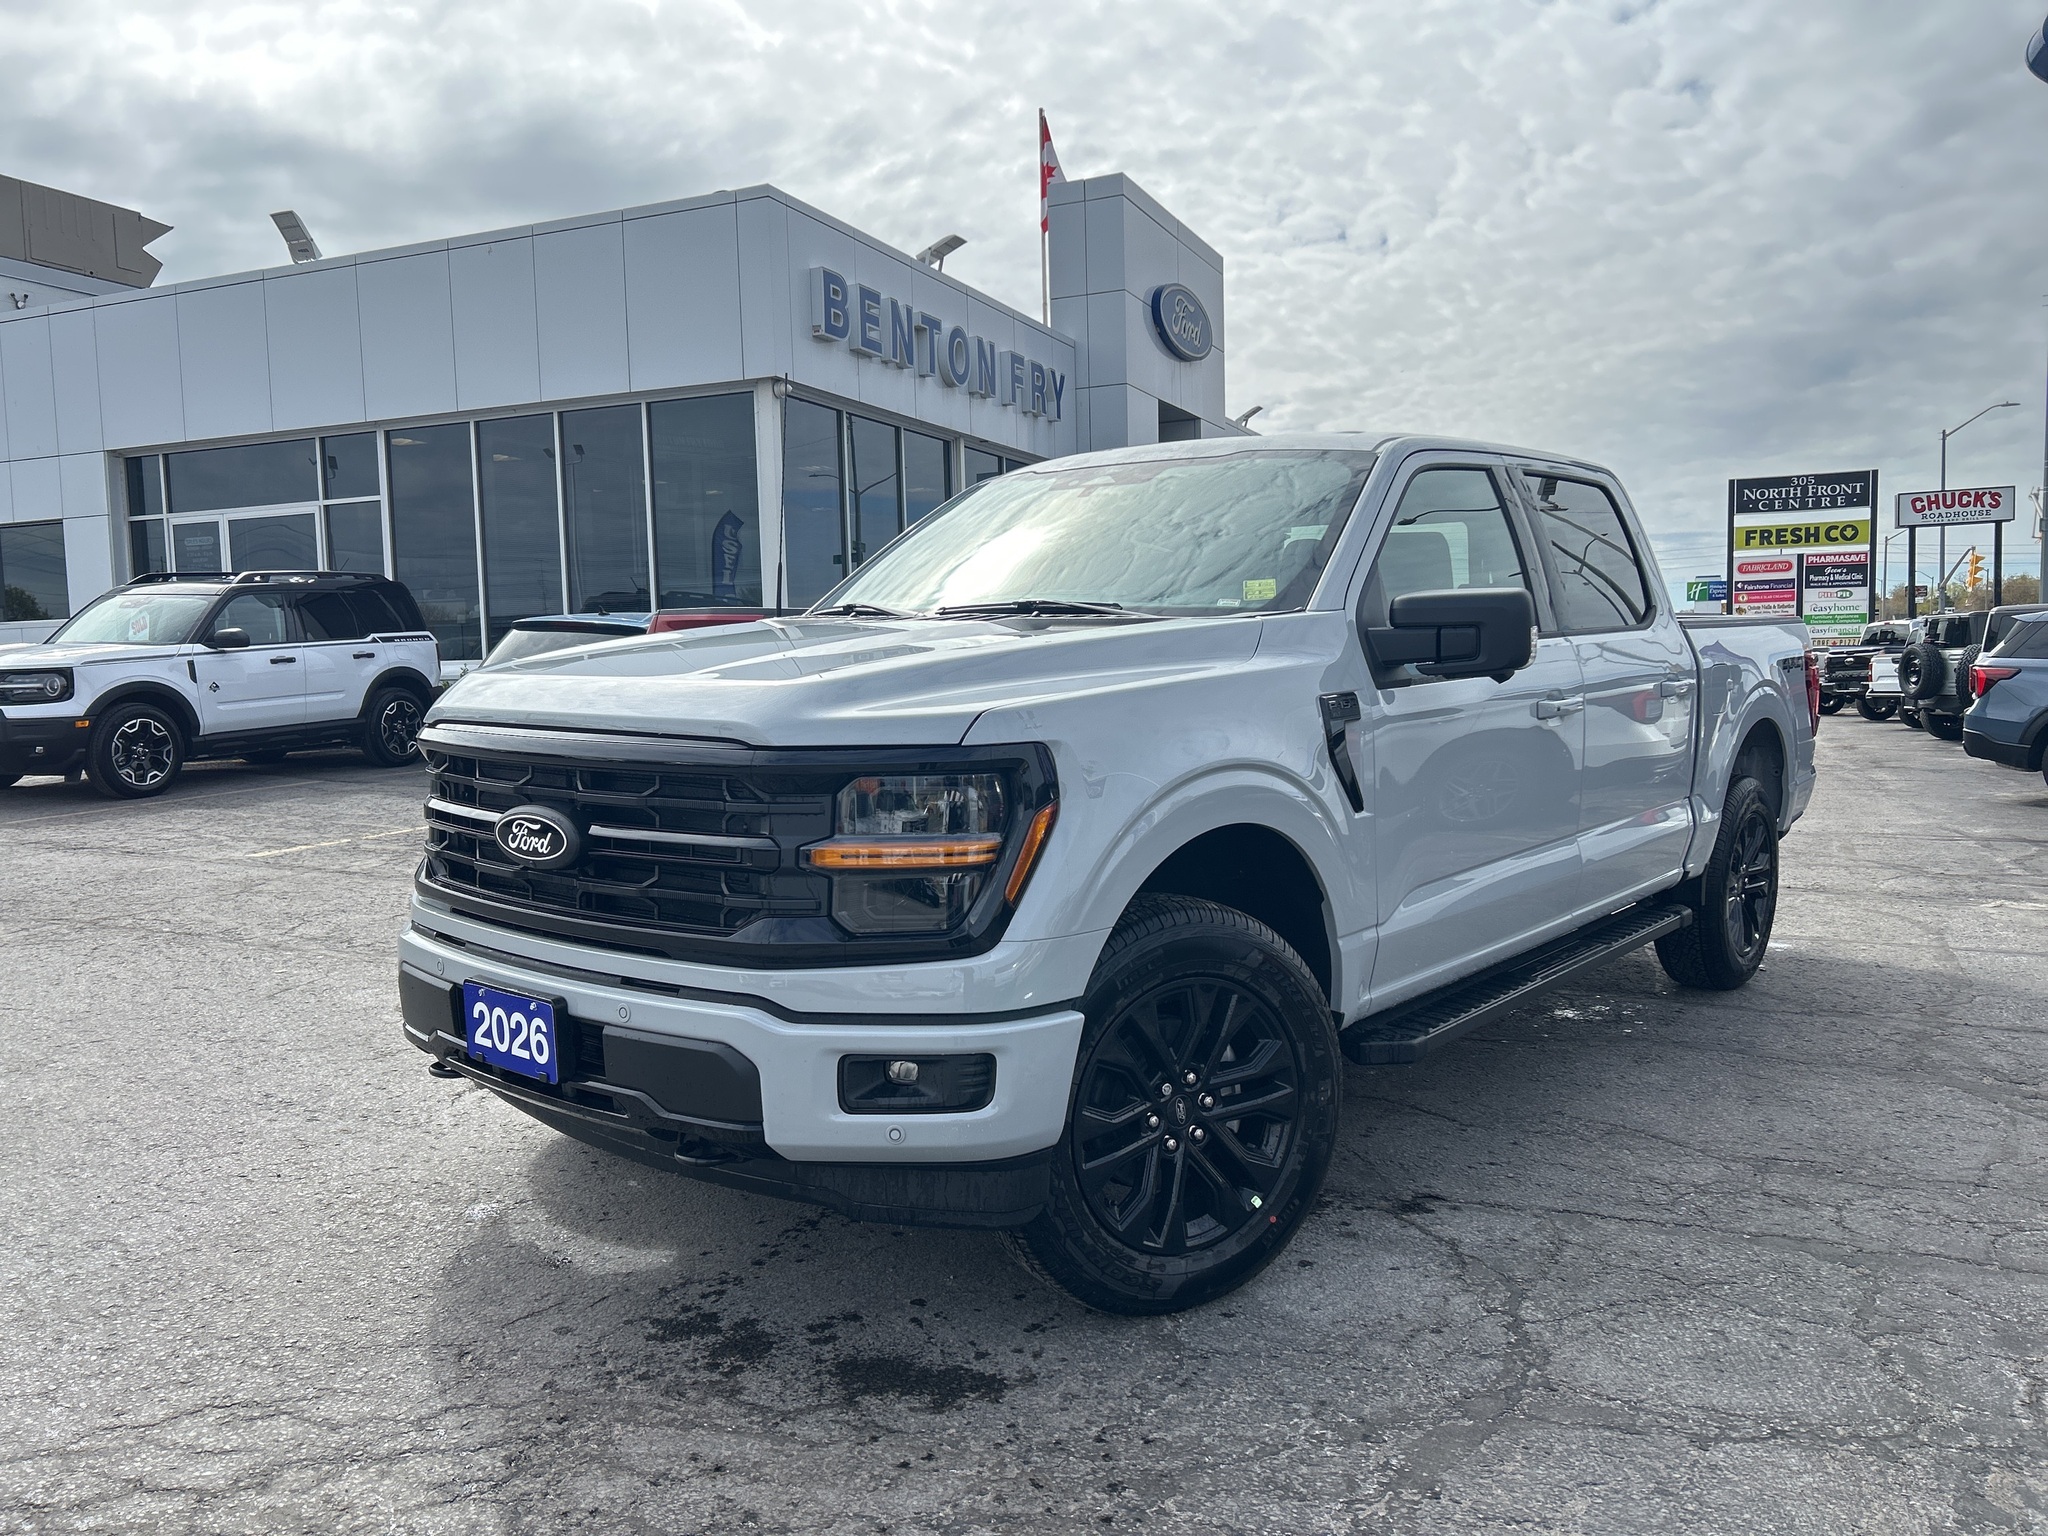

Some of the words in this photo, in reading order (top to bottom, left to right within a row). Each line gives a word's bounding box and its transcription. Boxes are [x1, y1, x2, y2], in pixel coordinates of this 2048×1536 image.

[1171, 295, 1203, 348] Ford
[810, 266, 997, 399] BENTON
[1001, 350, 1066, 422] FRY
[1790, 476, 1815, 486] 305
[1742, 486, 1801, 501] NORTH
[1807, 482, 1864, 497] FRONT
[1758, 495, 1846, 511] CENTRE
[1910, 490, 2003, 514] CHUCK'S
[1921, 509, 1992, 520] ROADHOUSE
[1744, 526, 1820, 547] FRESH
[1742, 562, 1789, 572] FABRICLAND
[1808, 553, 1866, 564] PHARMASAVE
[1809, 574, 1829, 582] Pharmacy
[1811, 603, 1860, 614] easyhome
[508, 820, 552, 854] Ford
[473, 1001, 549, 1065] 2026
